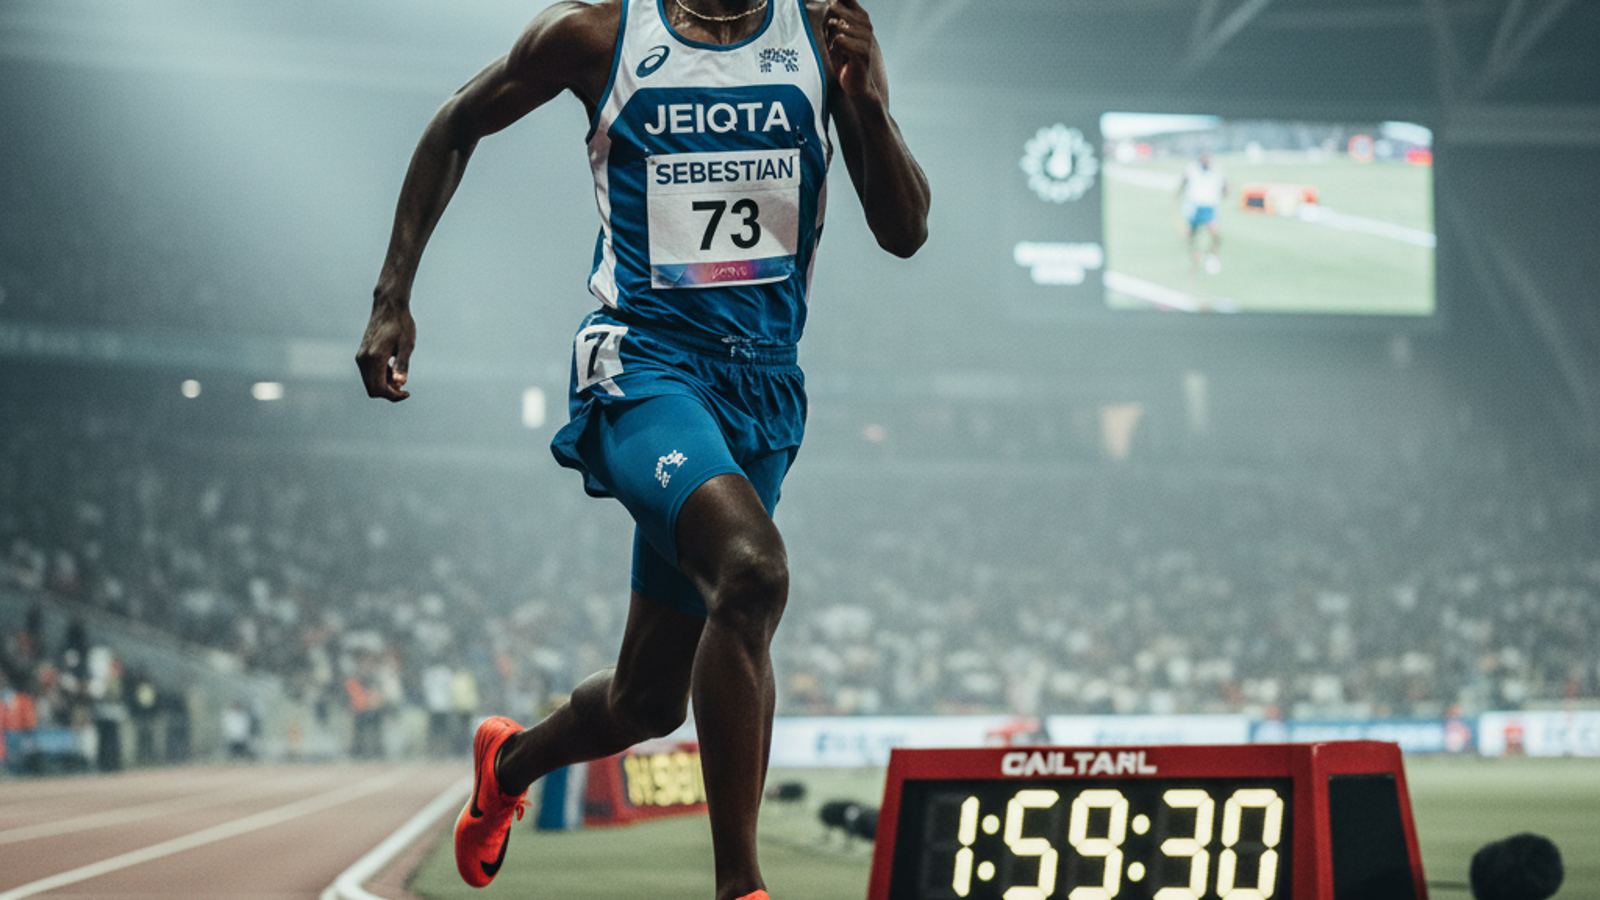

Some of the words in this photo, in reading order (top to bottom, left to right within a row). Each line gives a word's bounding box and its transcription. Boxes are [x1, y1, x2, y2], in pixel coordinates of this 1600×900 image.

[644, 101, 791, 135] JEIQTA
[655, 157, 794, 185] SEBESTIAN
[691, 198, 762, 251] 73
[584, 331, 610, 381] 7
[952, 789, 1284, 900] 1:59:30
